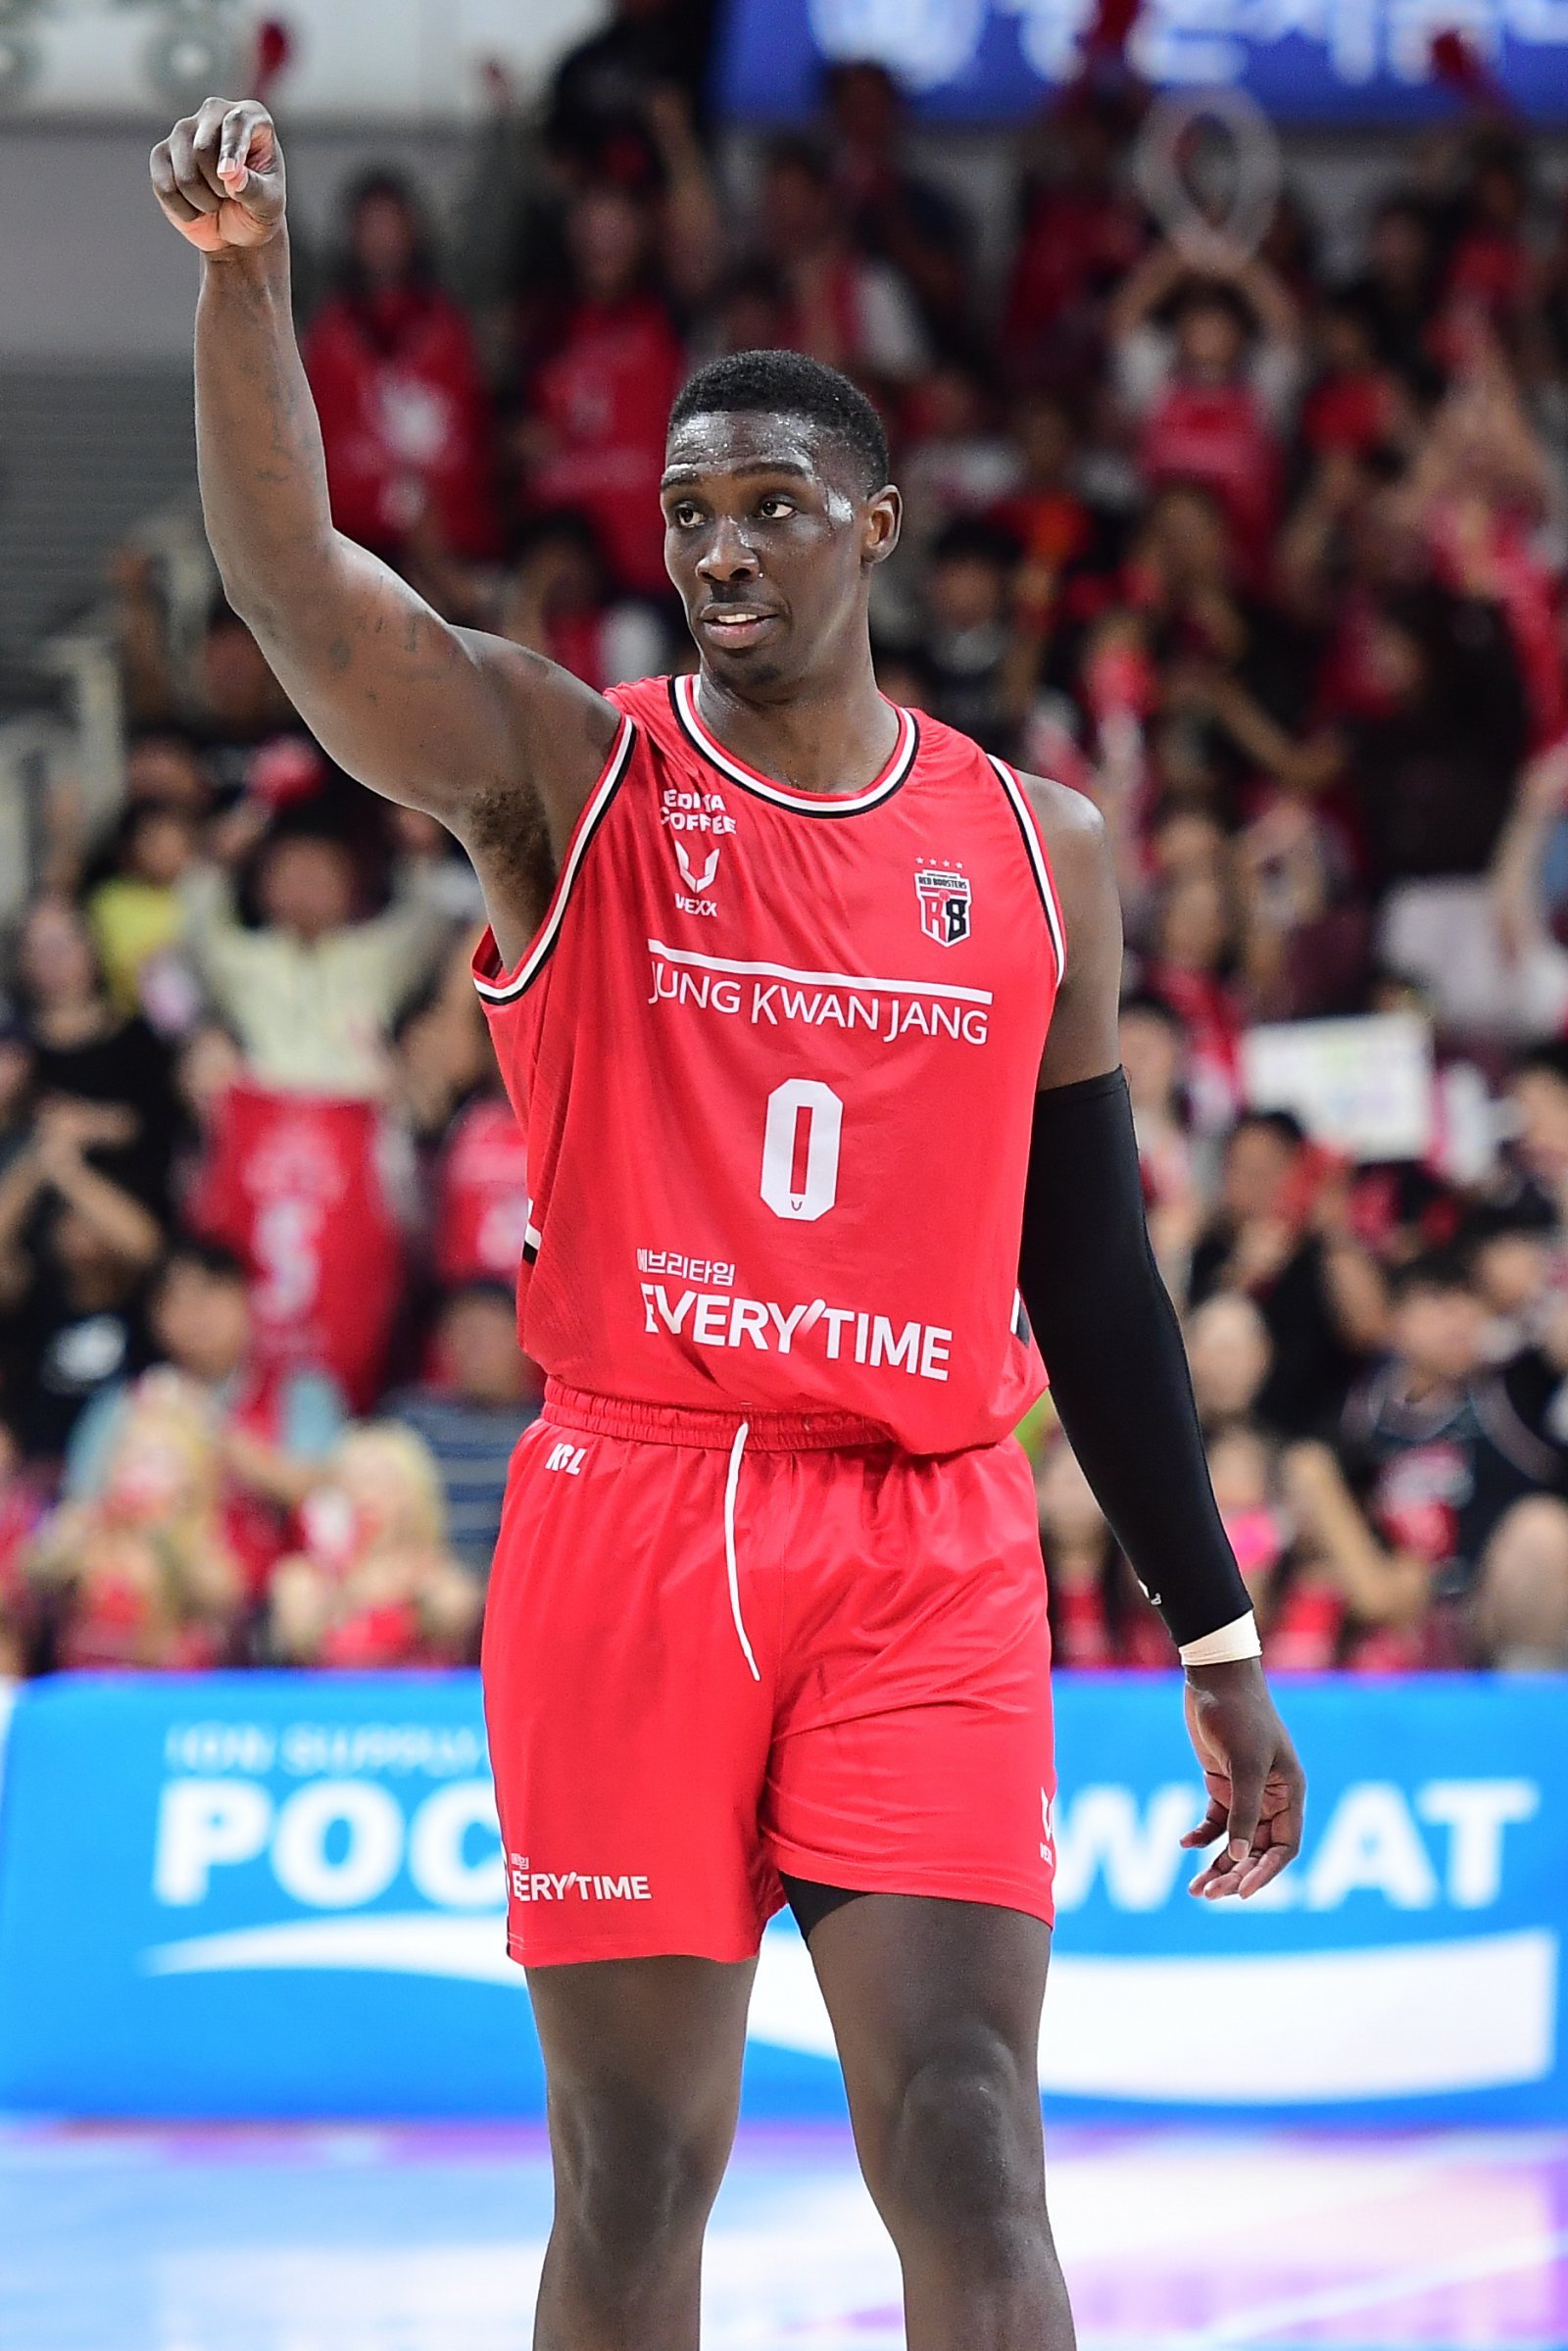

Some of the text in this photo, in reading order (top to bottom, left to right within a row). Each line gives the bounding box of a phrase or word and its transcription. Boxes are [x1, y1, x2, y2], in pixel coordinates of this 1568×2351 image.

[660, 806, 737, 835] COFFEE
[674, 892, 718, 917] VEXX
[648, 960, 989, 1046] JUNG KWAN JANG
[760, 1077, 844, 1221] 0
[545, 1442, 587, 1476] KBL
